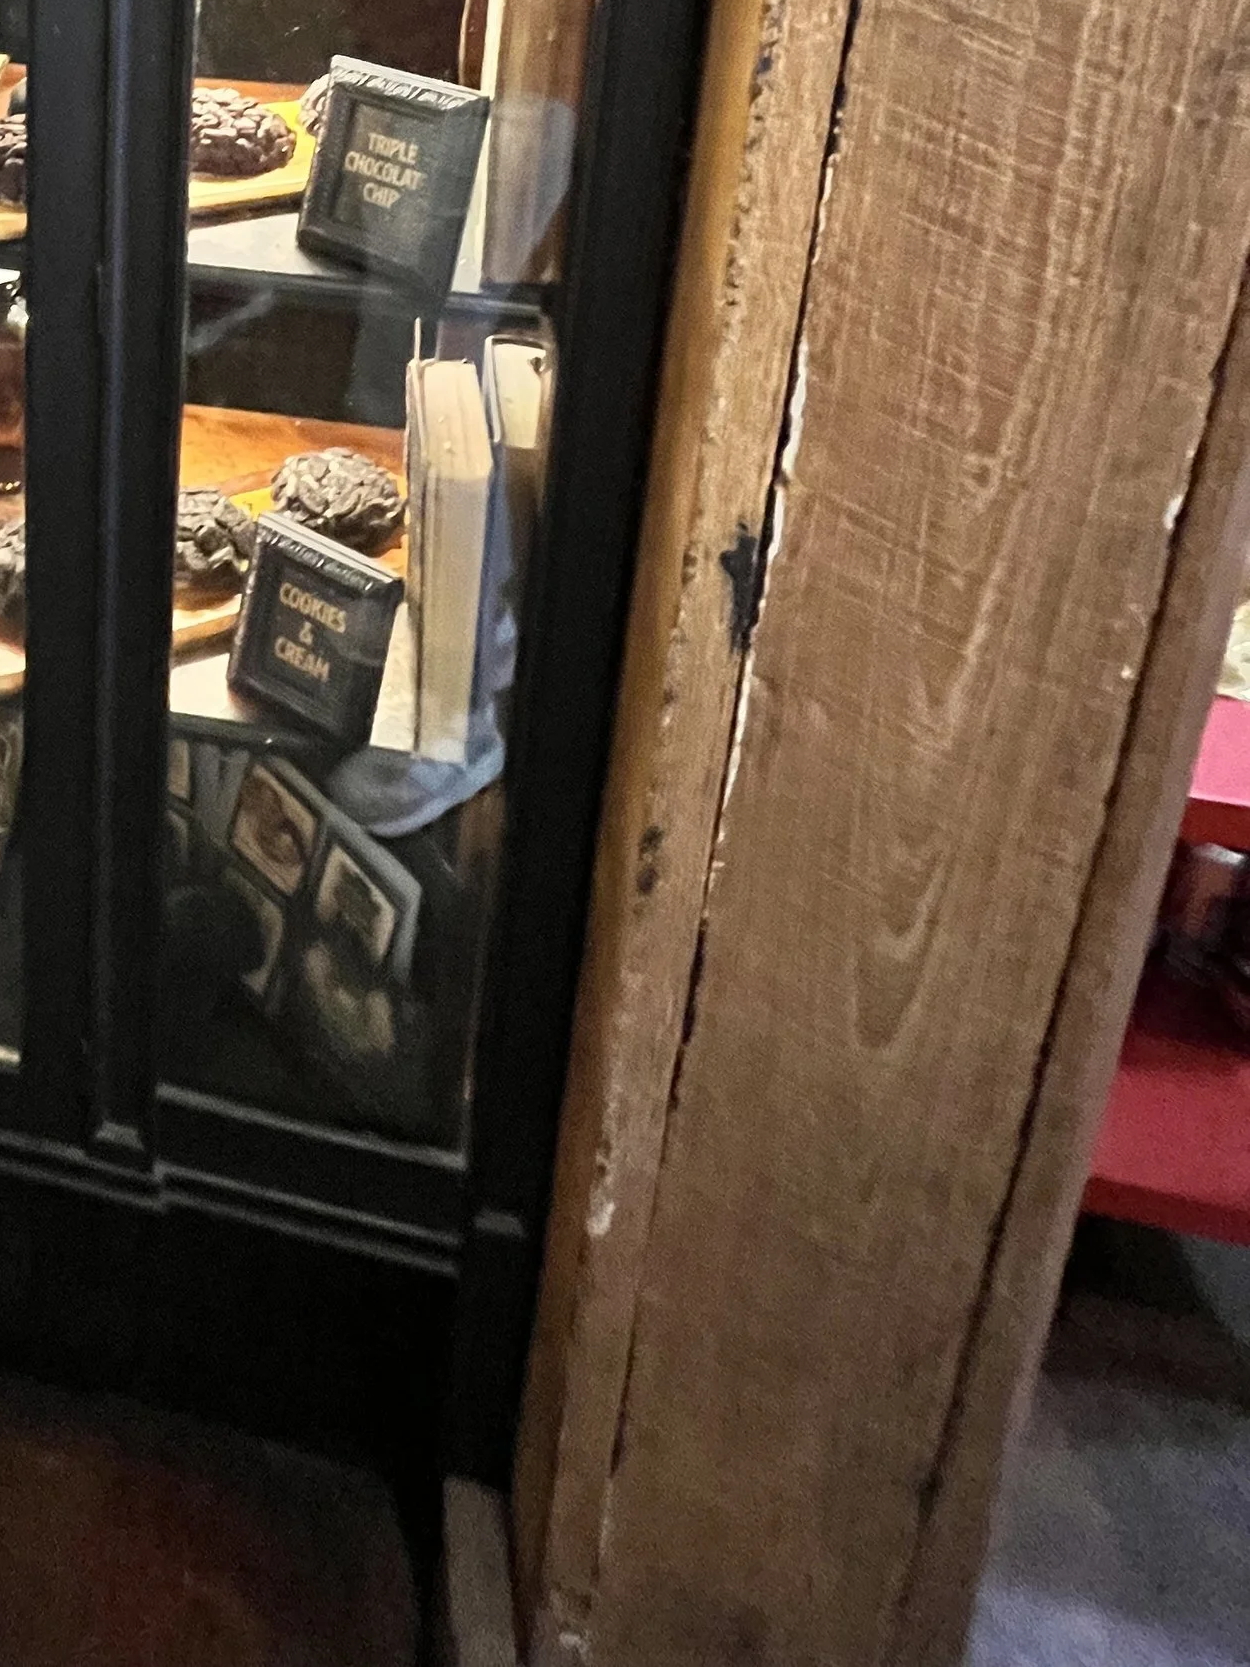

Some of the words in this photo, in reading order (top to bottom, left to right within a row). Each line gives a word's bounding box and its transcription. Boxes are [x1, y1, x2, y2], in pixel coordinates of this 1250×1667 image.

[368, 132, 419, 165] TRIPLE
[363, 182, 401, 209] CHIP
[280, 581, 347, 634] COOKIES
[299, 621, 314, 646] &
[274, 636, 330, 683] CREAM
